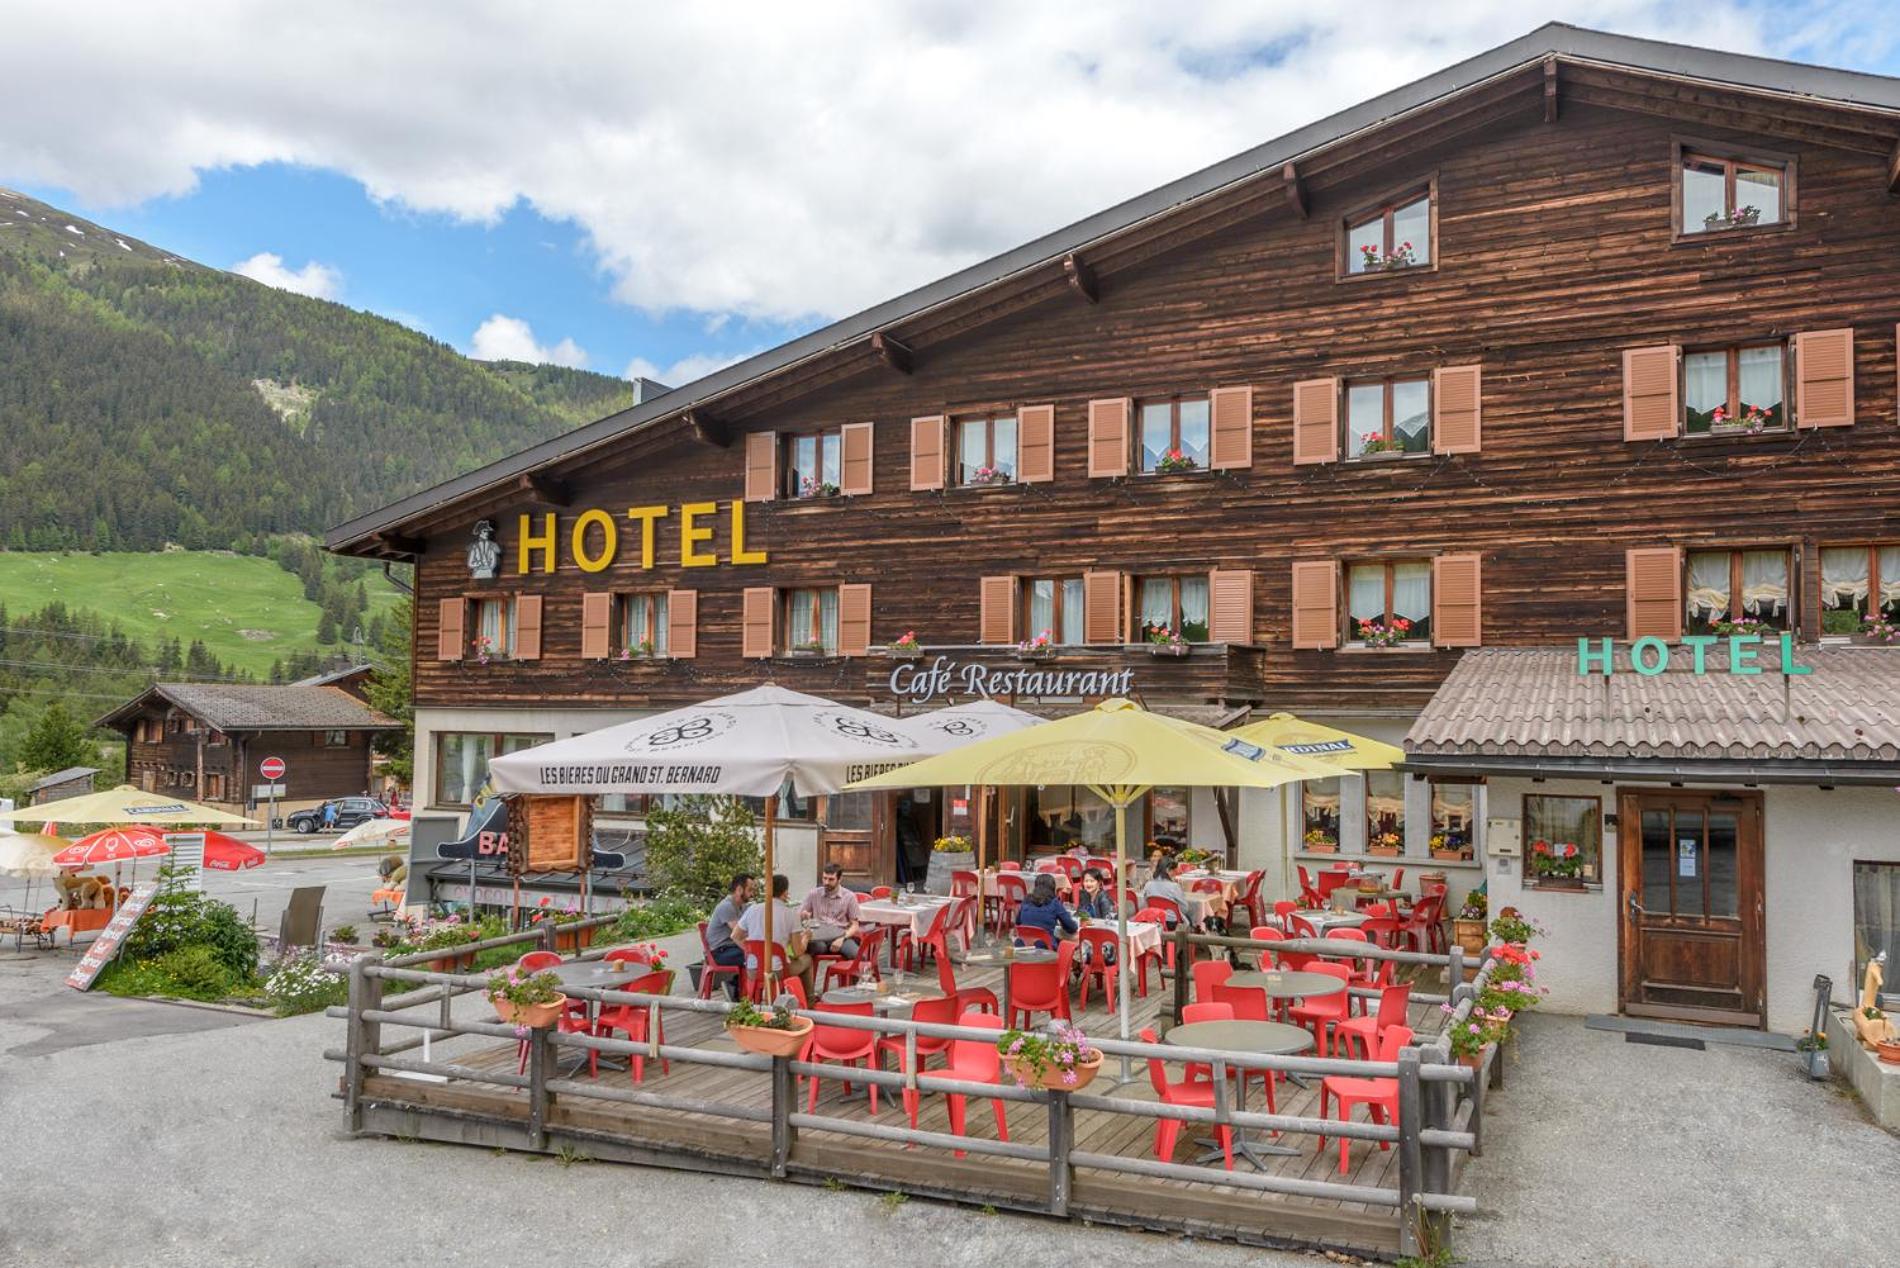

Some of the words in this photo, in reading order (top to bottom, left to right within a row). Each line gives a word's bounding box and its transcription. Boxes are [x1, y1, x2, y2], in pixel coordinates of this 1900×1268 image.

[518, 500, 768, 574] HOTEL
[1578, 631, 1813, 676] HOTEL
[890, 655, 956, 704] Café
[961, 664, 1134, 699] Restaurant
[540, 767, 558, 784] LES
[559, 766, 595, 784] BIERES
[596, 766, 610, 784] DU
[611, 766, 648, 784] GRAND
[648, 766, 664, 784] ST.
[665, 766, 721, 784] BERNARD
[846, 765, 863, 784] LES
